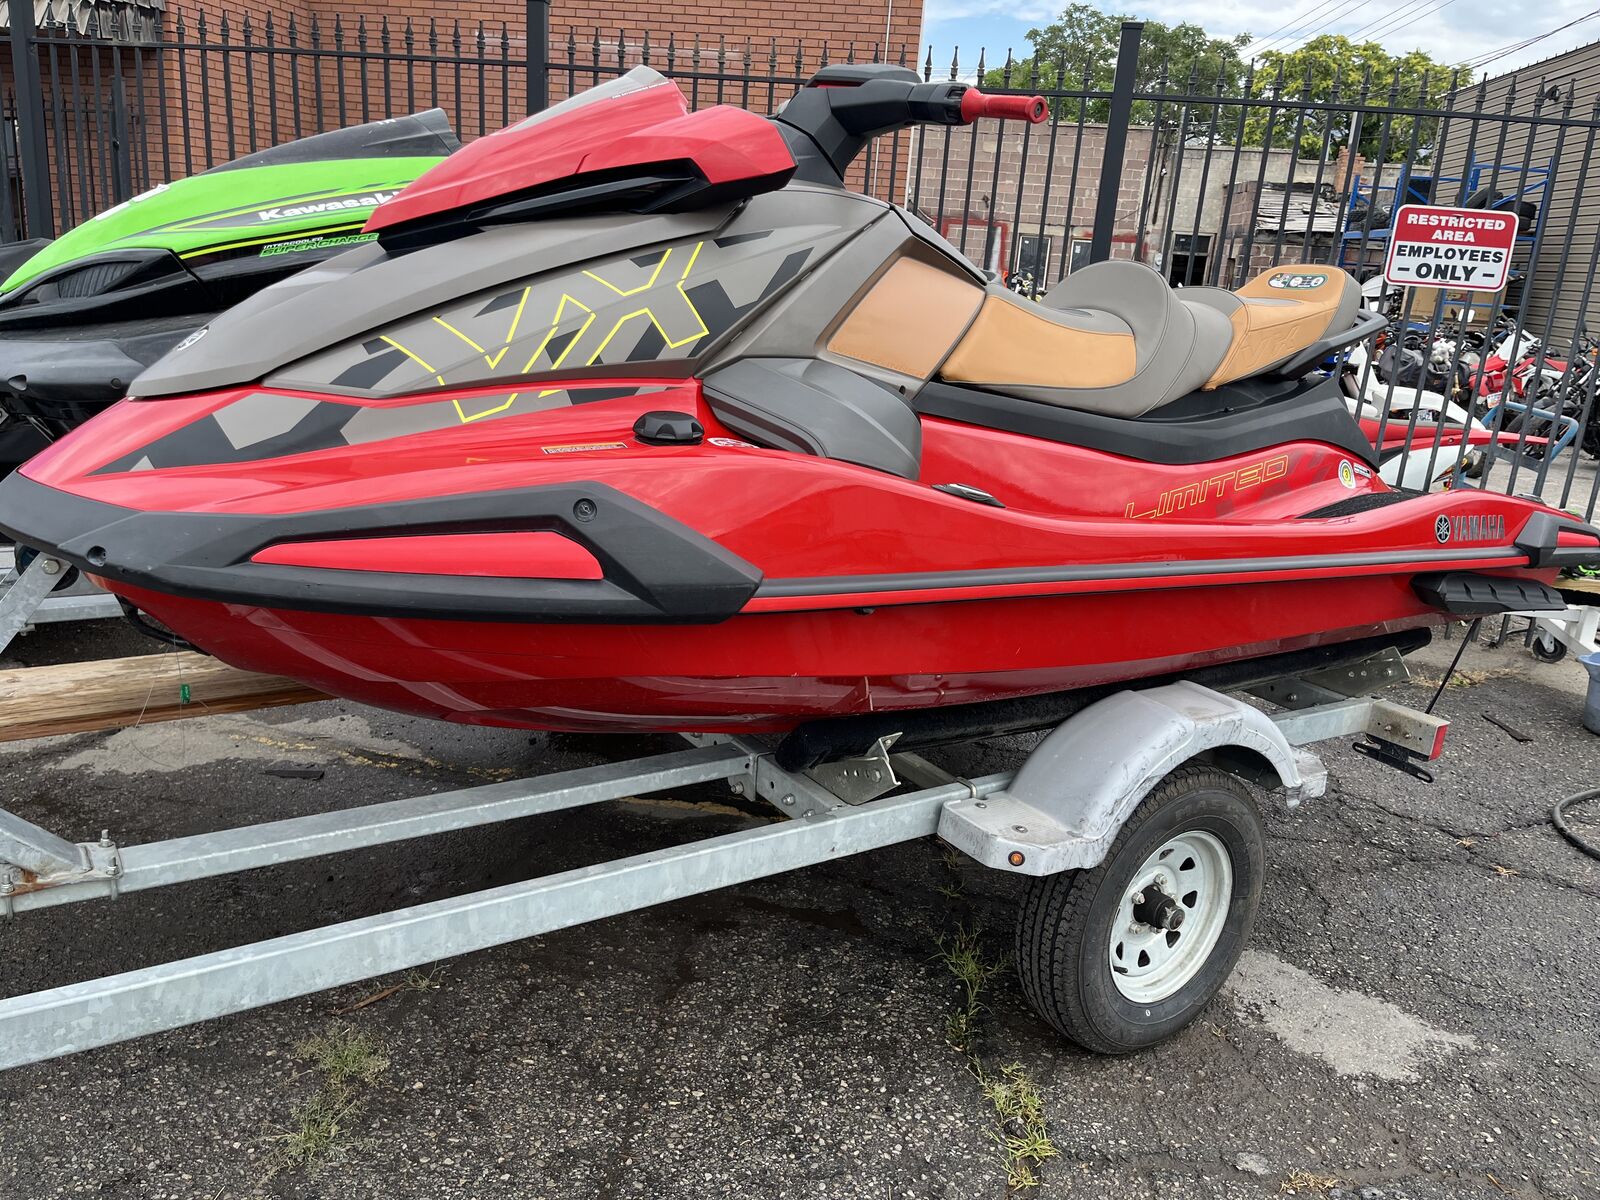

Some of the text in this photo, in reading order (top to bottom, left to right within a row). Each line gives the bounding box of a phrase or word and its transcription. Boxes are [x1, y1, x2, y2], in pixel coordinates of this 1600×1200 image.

[1407, 213, 1506, 231] RESTRICTED
[1431, 229, 1475, 243] AREA
[1396, 244, 1503, 264] EMPLOYEES
[1415, 262, 1477, 282] ONLY
[1124, 454, 1289, 519] LIMITED
[1451, 514, 1505, 541] YAMAHA
